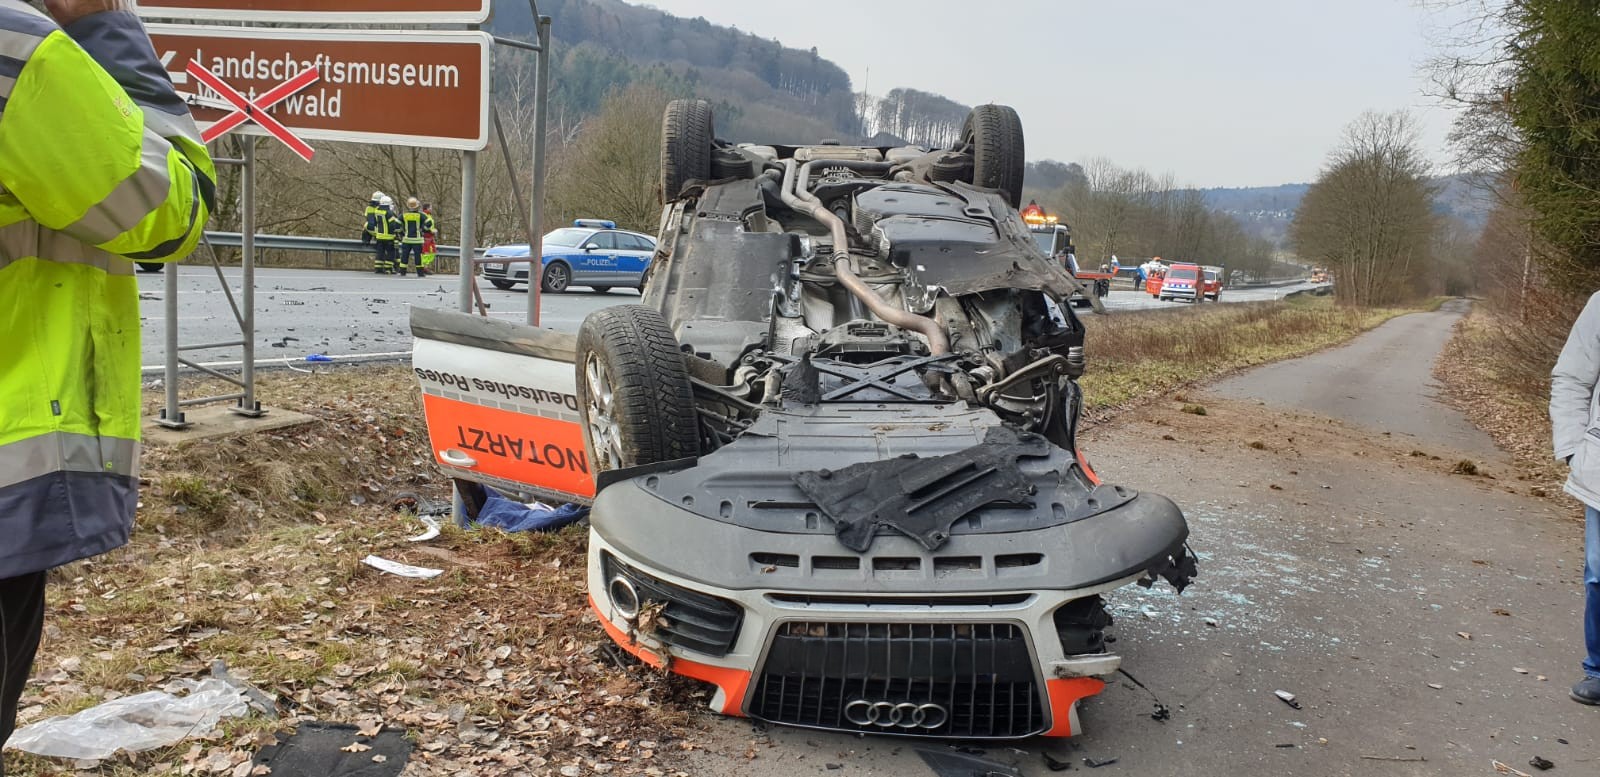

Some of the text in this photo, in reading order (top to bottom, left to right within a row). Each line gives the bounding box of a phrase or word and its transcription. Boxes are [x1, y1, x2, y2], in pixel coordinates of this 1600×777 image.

[587, 258, 611, 266] POLIZEI
[414, 367, 579, 411] Deutsches Rotes
[457, 425, 589, 474] NOTARZT
